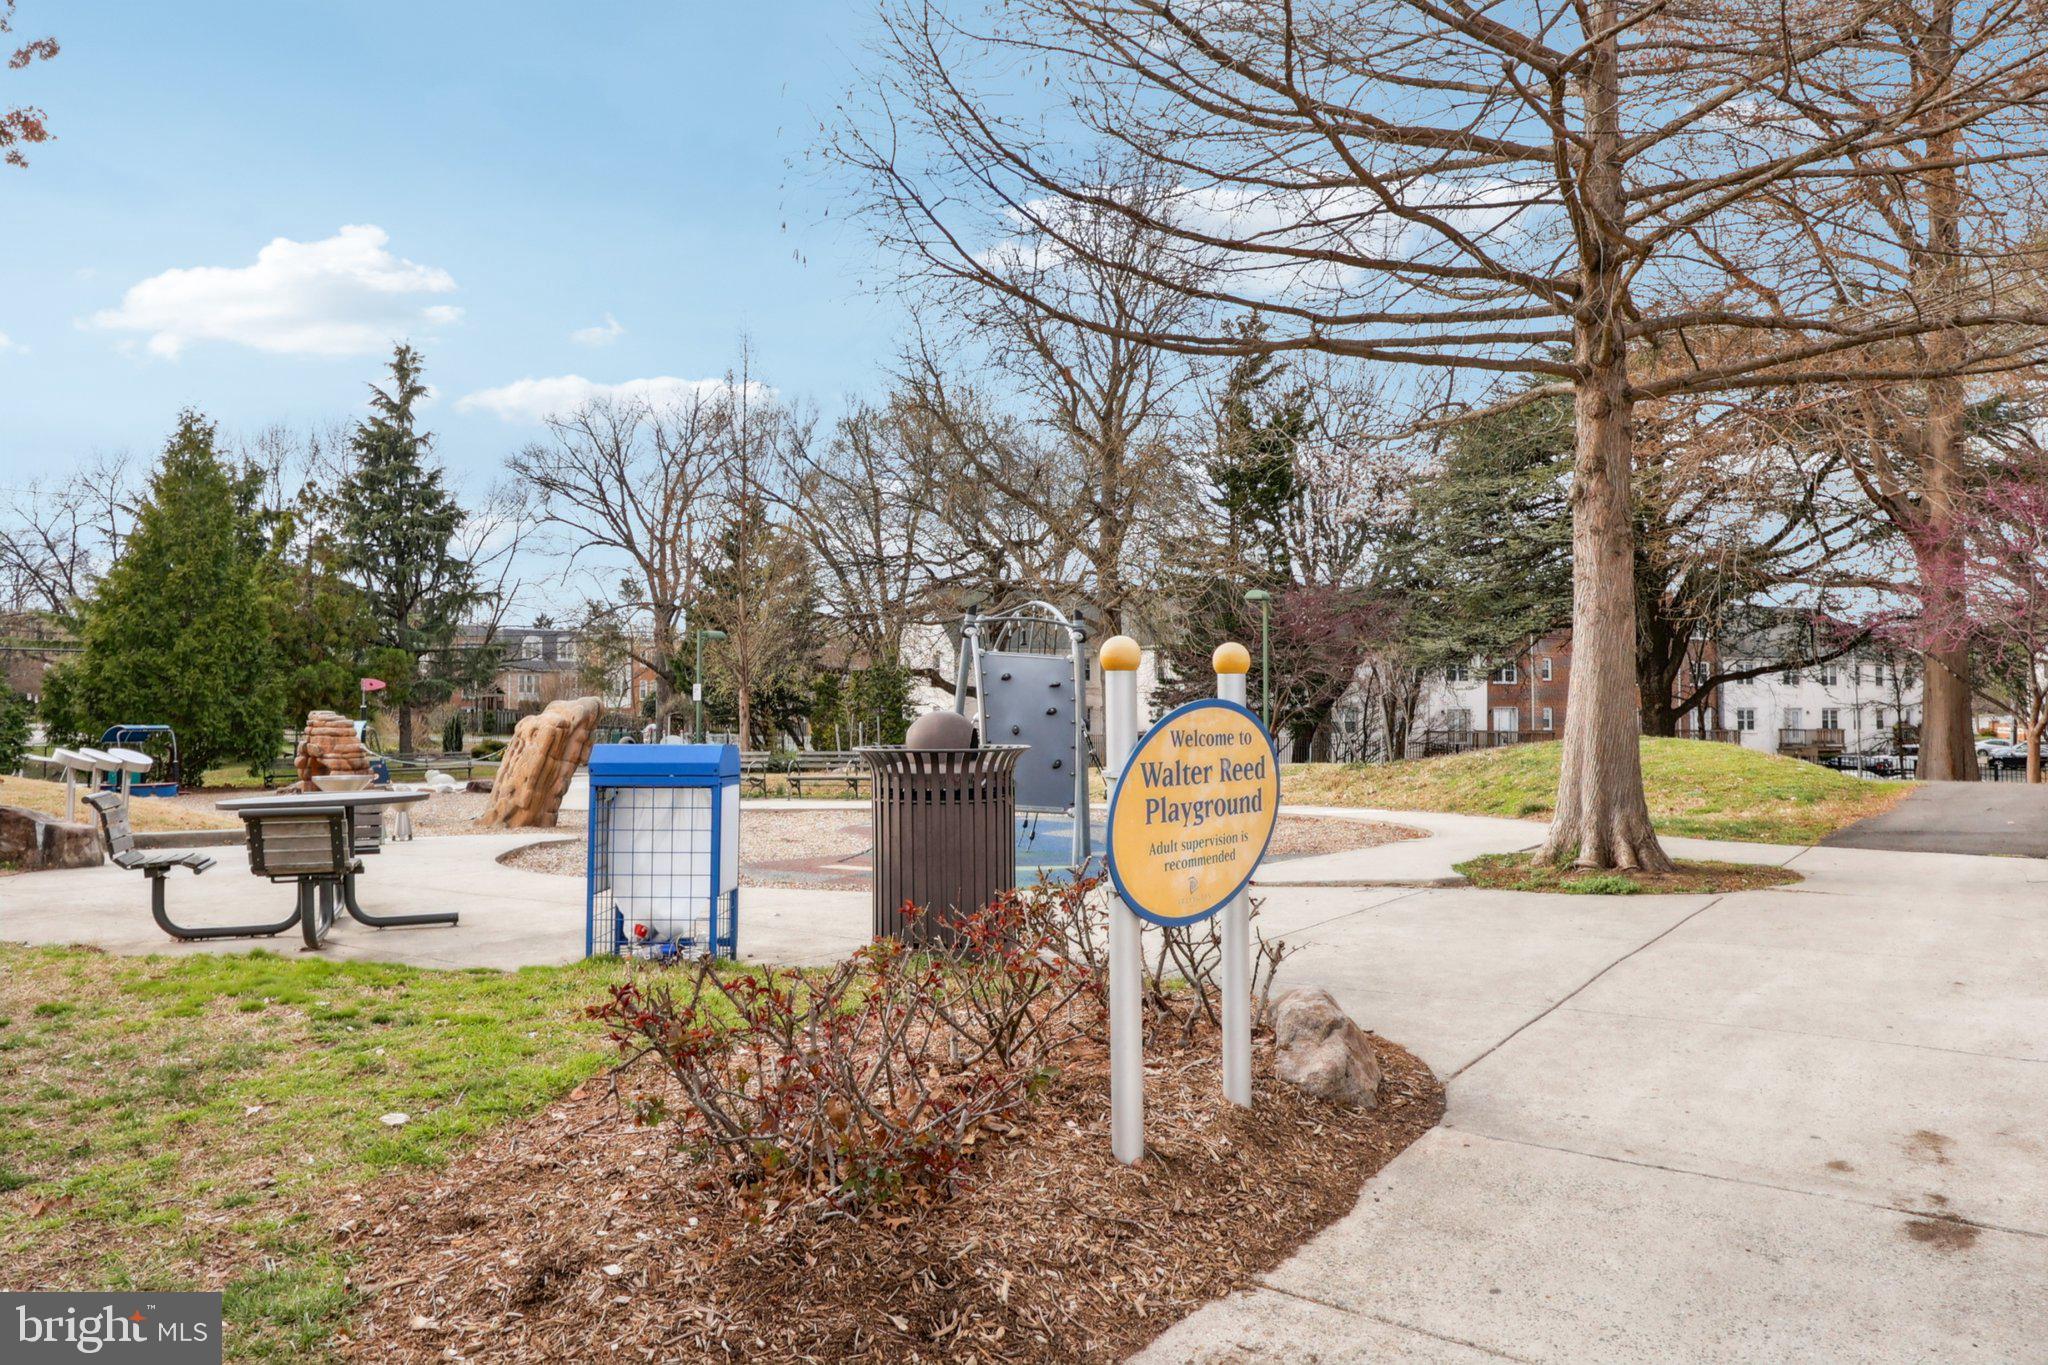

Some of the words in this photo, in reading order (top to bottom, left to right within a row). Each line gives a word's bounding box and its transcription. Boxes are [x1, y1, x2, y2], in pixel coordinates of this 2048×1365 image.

[1170, 729, 1235, 748] Welcome
[1239, 730, 1252, 746] to
[1140, 759, 1213, 788] Walter
[1219, 755, 1266, 783] Reed
[1145, 787, 1263, 828] Playground
[1149, 839, 1178, 856] Adult
[1181, 832, 1238, 853] supervision
[1241, 830, 1249, 843] is
[1164, 848, 1236, 872] recommended
